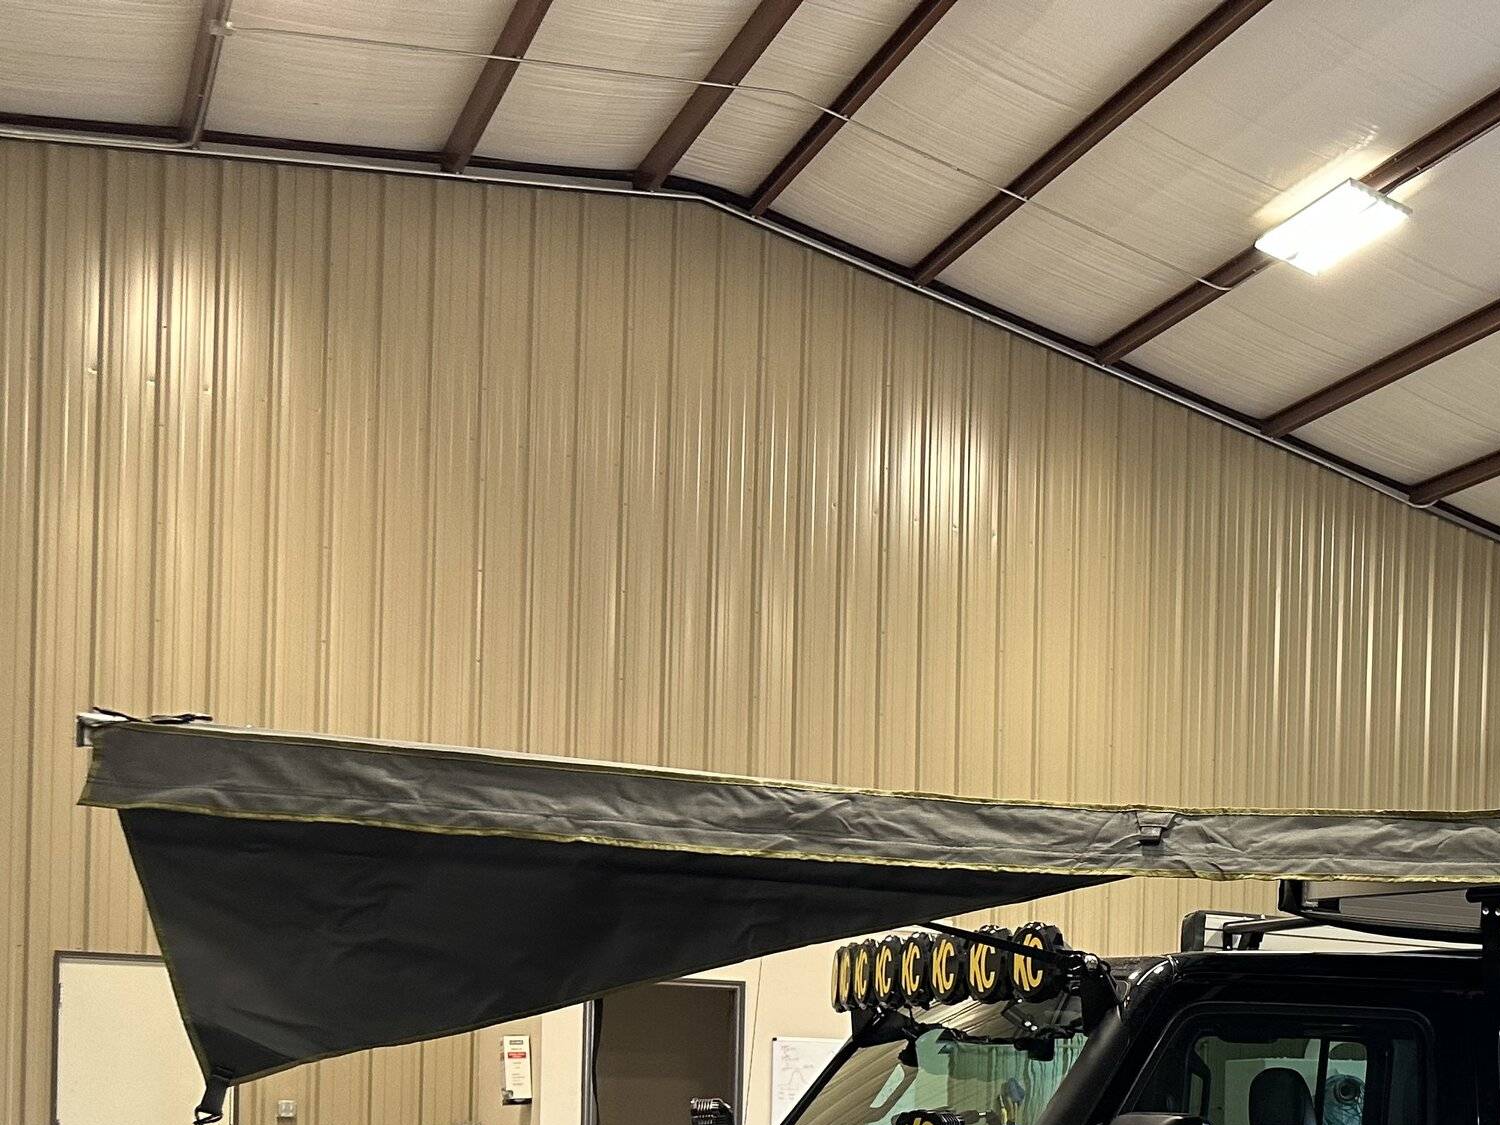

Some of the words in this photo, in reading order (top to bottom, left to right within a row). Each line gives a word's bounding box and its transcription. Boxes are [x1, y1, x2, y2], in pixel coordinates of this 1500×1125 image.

[875, 945, 892, 998] KC
[901, 942, 920, 996] KC
[932, 939, 955, 994] KC
[969, 942, 996, 993] KC
[1013, 933, 1044, 992] KC
